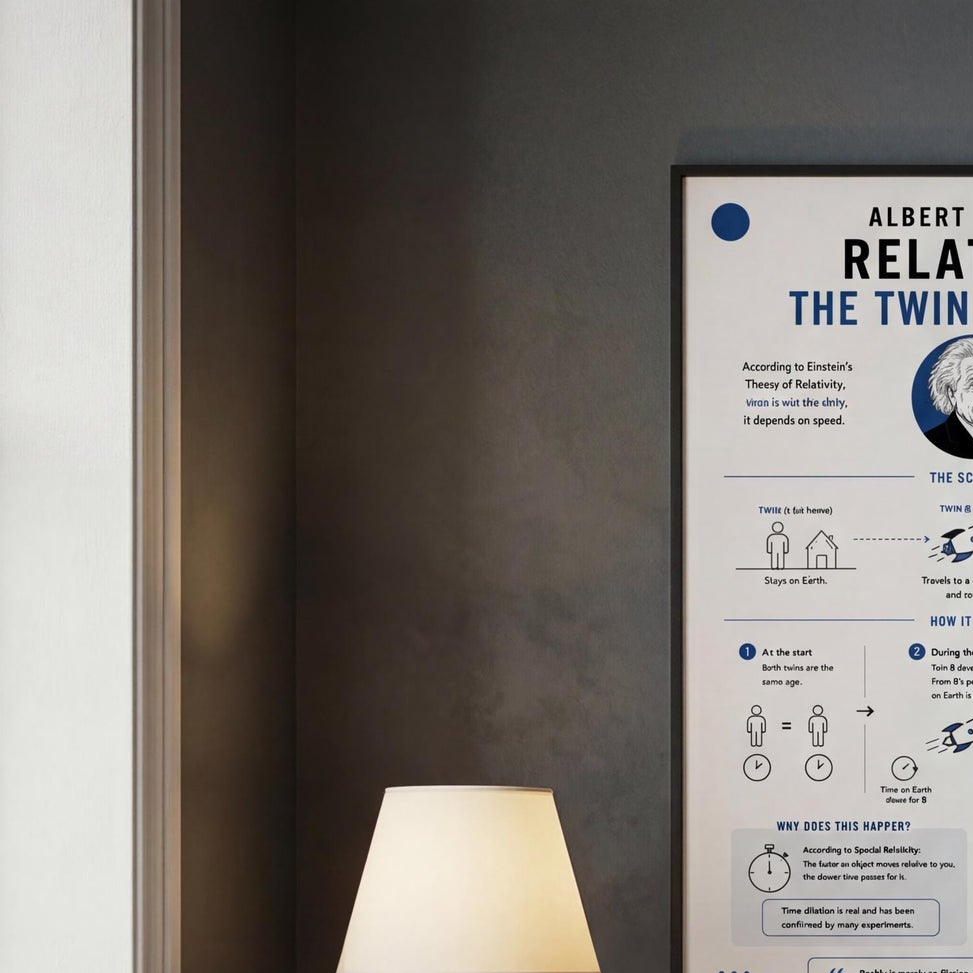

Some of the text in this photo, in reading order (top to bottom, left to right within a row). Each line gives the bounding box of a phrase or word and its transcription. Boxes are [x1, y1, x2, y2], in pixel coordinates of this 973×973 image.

[868, 206, 965, 227] ALBERT
[788, 290, 858, 326] THE
[874, 290, 968, 326] TWIN
[742, 361, 853, 375] According to Einstein's
[781, 378, 793, 390] of
[795, 378, 846, 392] Relativity,
[771, 397, 780, 408] is
[743, 414, 845, 428] it depends on speed.
[929, 471, 953, 484] THE
[939, 504, 963, 513] TWIN
[953, 577, 963, 585] to
[945, 590, 962, 599] and
[930, 615, 957, 627] HOW
[961, 615, 972, 627] IT
[761, 648, 774, 657] At
[776, 647, 791, 657] the
[792, 649, 813, 657] start
[931, 647, 961, 659] During
[783, 663, 804, 672] twins
[820, 663, 834, 672] the
[785, 679, 803, 688] age.
[931, 677, 952, 686] From
[943, 691, 964, 700] Earth
[965, 691, 972, 700] is
[908, 795, 920, 804] for
[803, 821, 831, 832] DOES
[834, 821, 859, 832] THIS
[802, 845, 842, 856] According
[802, 860, 817, 868] The
[802, 872, 816, 881] the
[886, 872, 898, 881] for
[781, 906, 802, 915] Time
[836, 906, 844, 915] is
[845, 906, 860, 915] real
[861, 906, 877, 915] and
[879, 906, 893, 915] has
[894, 906, 915, 915] been
[824, 920, 835, 931] by
